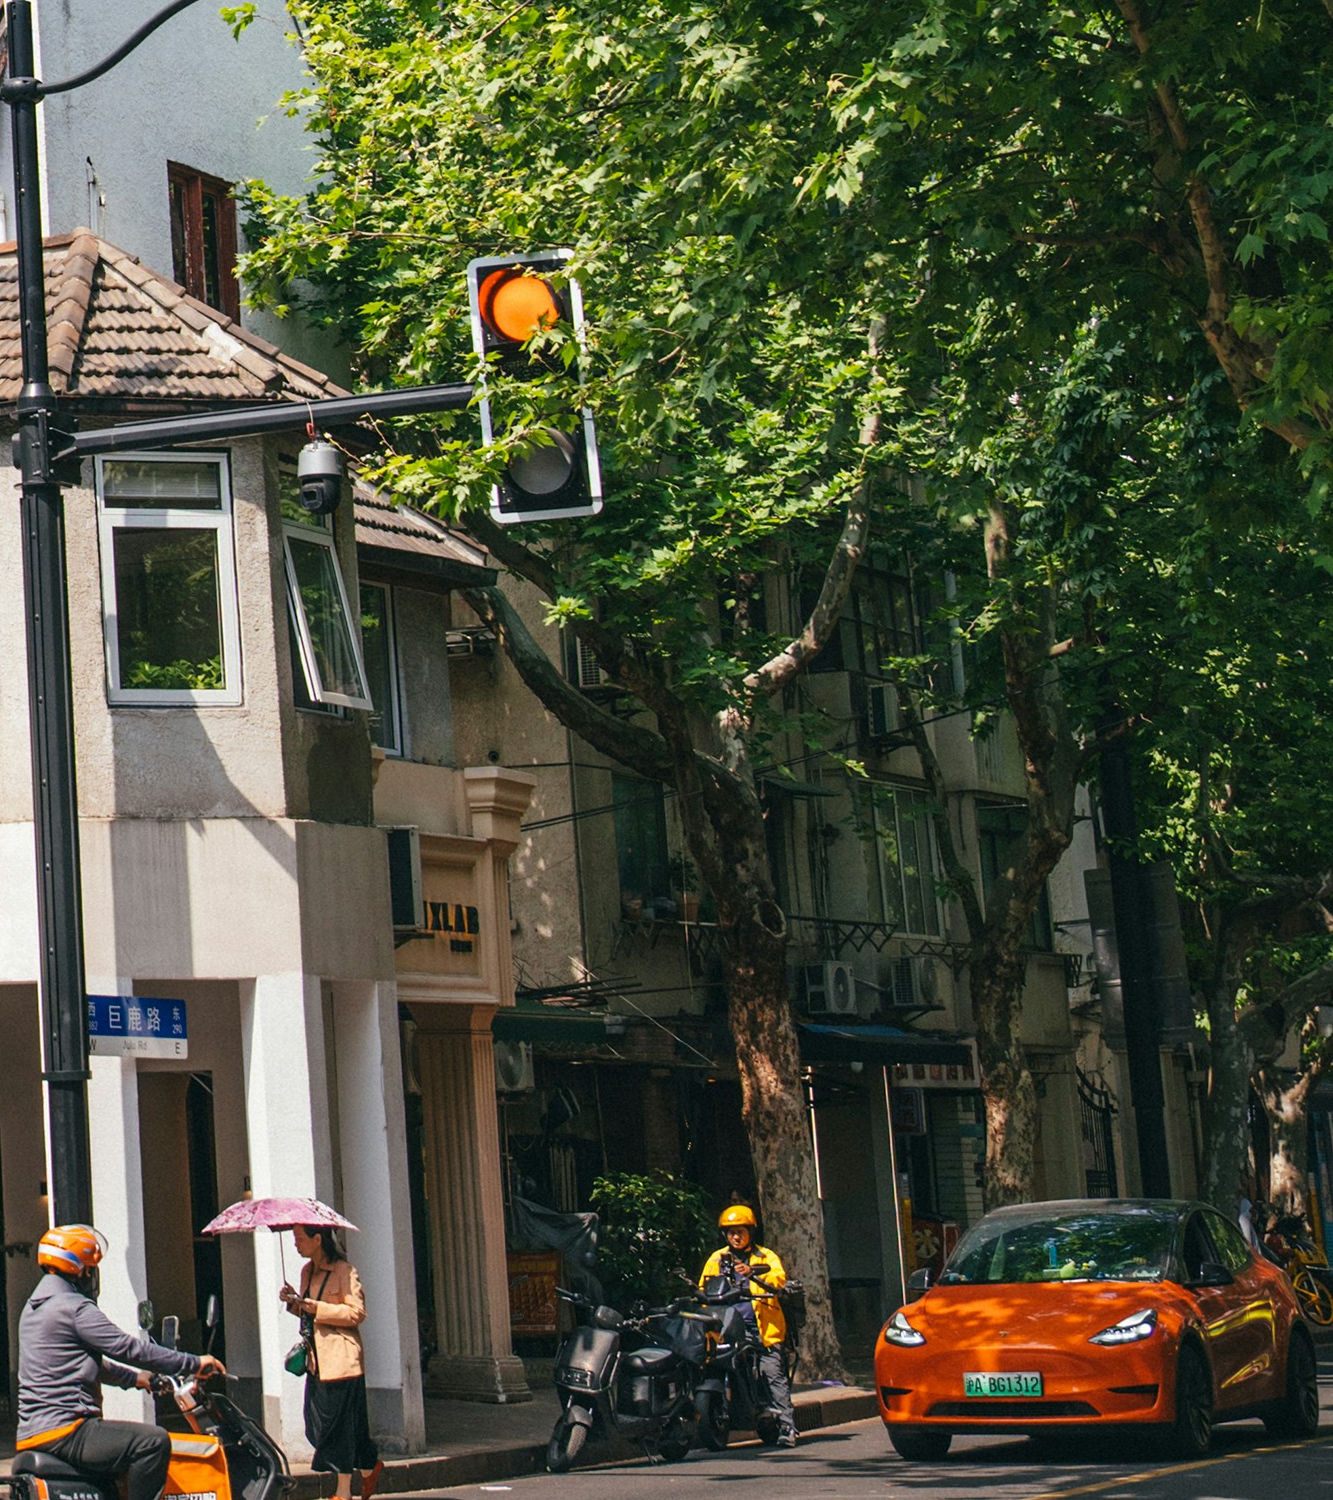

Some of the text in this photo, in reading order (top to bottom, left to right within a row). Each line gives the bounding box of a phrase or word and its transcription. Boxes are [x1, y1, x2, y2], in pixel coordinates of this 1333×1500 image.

[108, 1005, 161, 1031] 巨鹿路
[172, 1024, 183, 1034] 290
[175, 1042, 181, 1054] E
[989, 1375, 1040, 1393] BG1312
